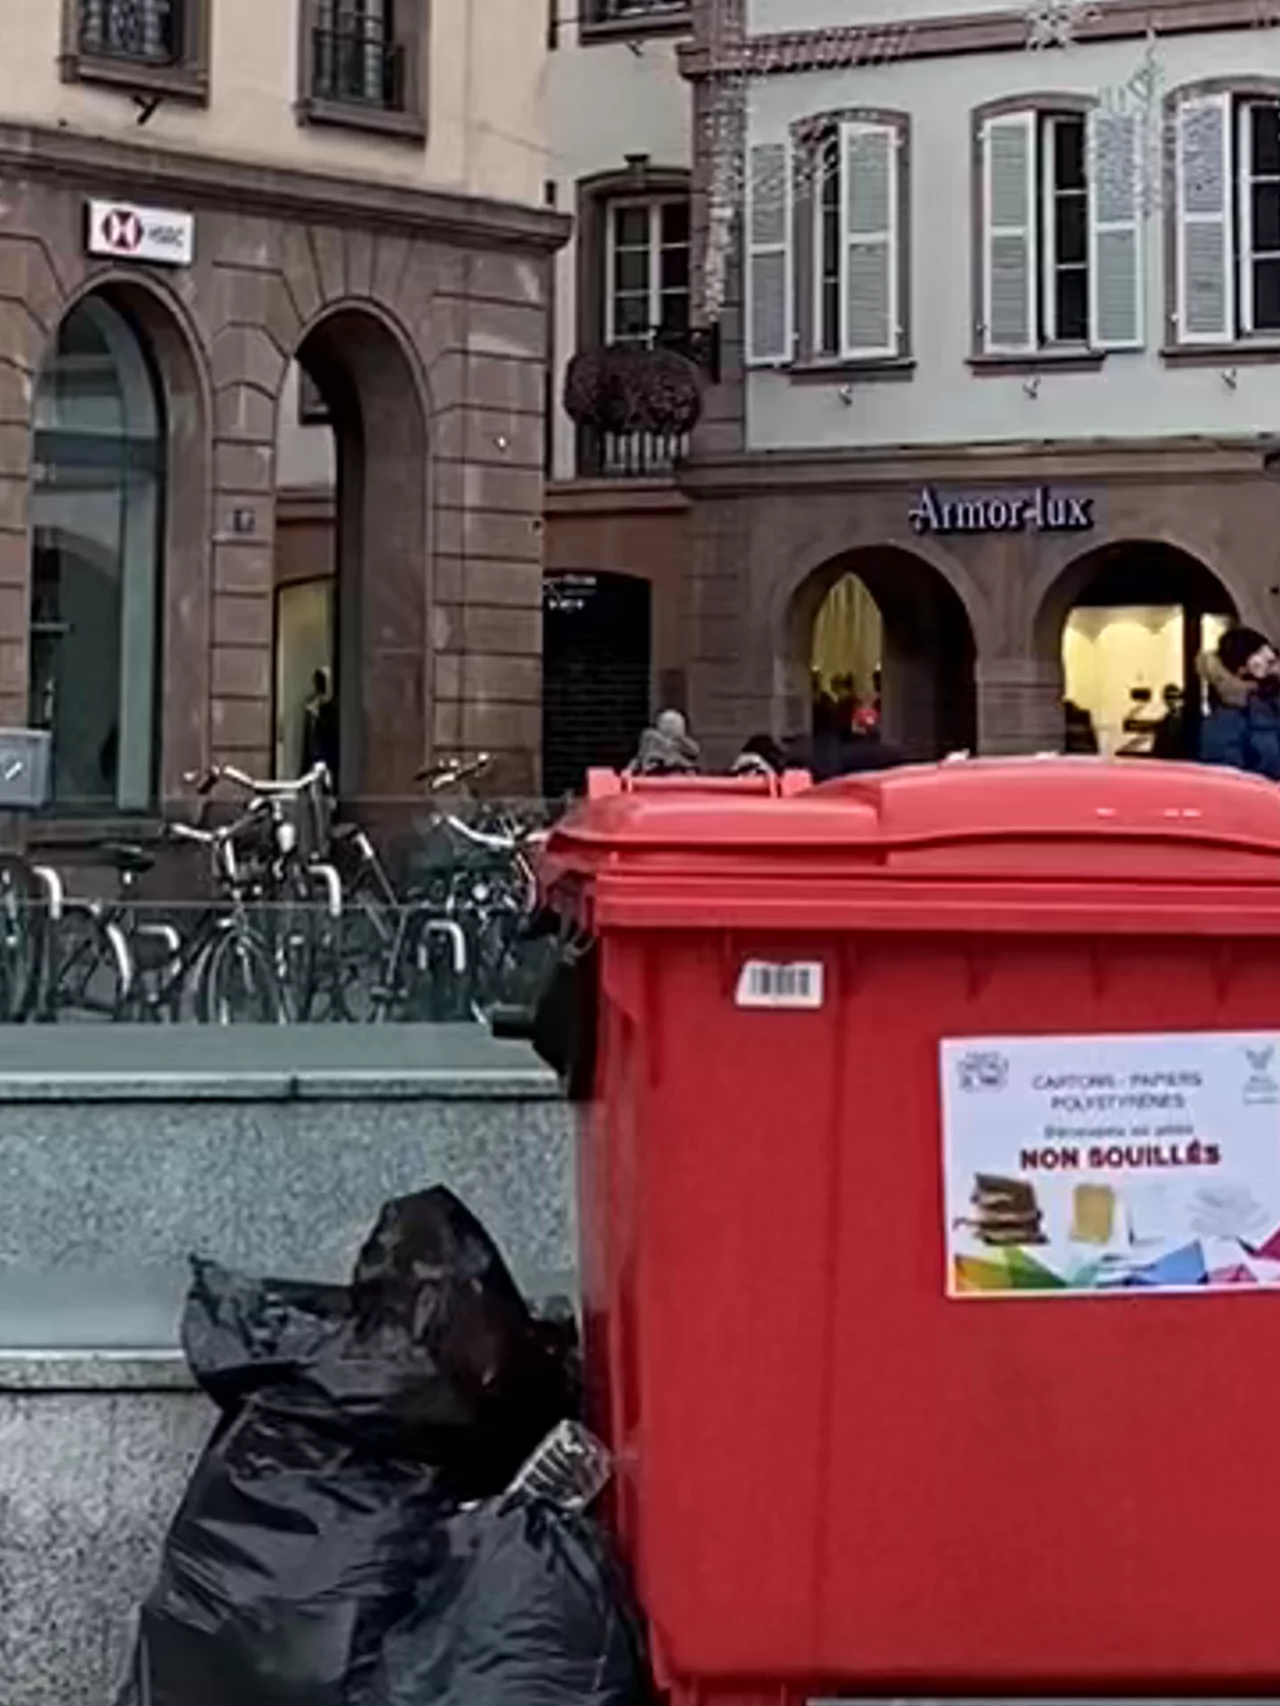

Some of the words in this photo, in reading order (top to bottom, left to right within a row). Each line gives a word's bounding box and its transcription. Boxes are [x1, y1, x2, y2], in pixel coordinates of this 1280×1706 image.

[908, 486, 1089, 532] Armor-lux
[1020, 1146, 1079, 1171] NON
[1088, 1137, 1222, 1169] SOUILLÉS
